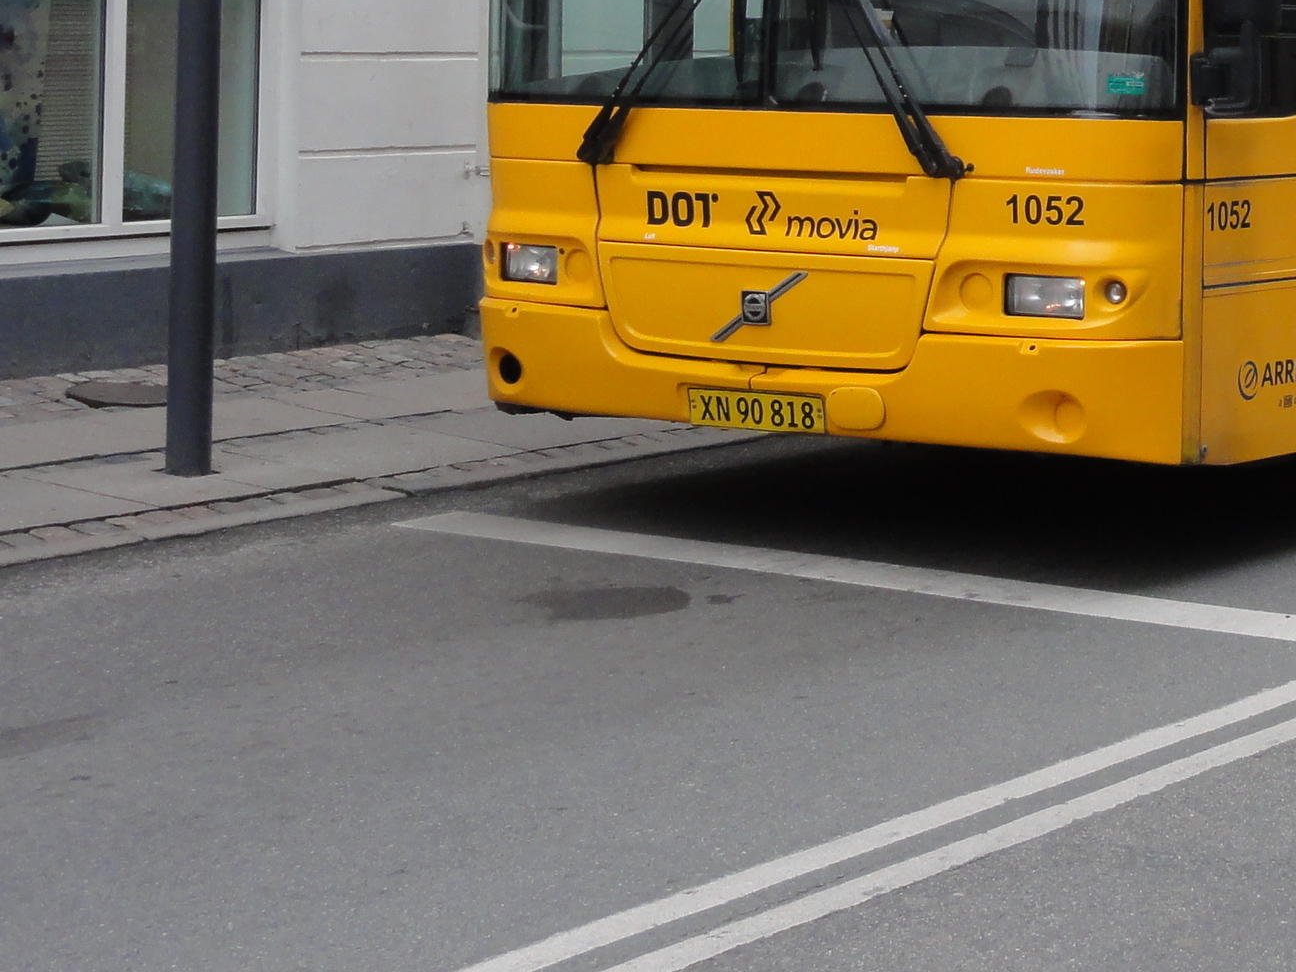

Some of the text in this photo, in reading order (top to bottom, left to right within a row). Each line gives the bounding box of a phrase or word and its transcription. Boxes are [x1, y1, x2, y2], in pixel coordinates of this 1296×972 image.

[646, 190, 719, 228] DOT
[784, 209, 879, 241] movia
[1005, 193, 1085, 226] 1052
[1206, 199, 1251, 232] 1052
[699, 394, 815, 429] XN 90 818
